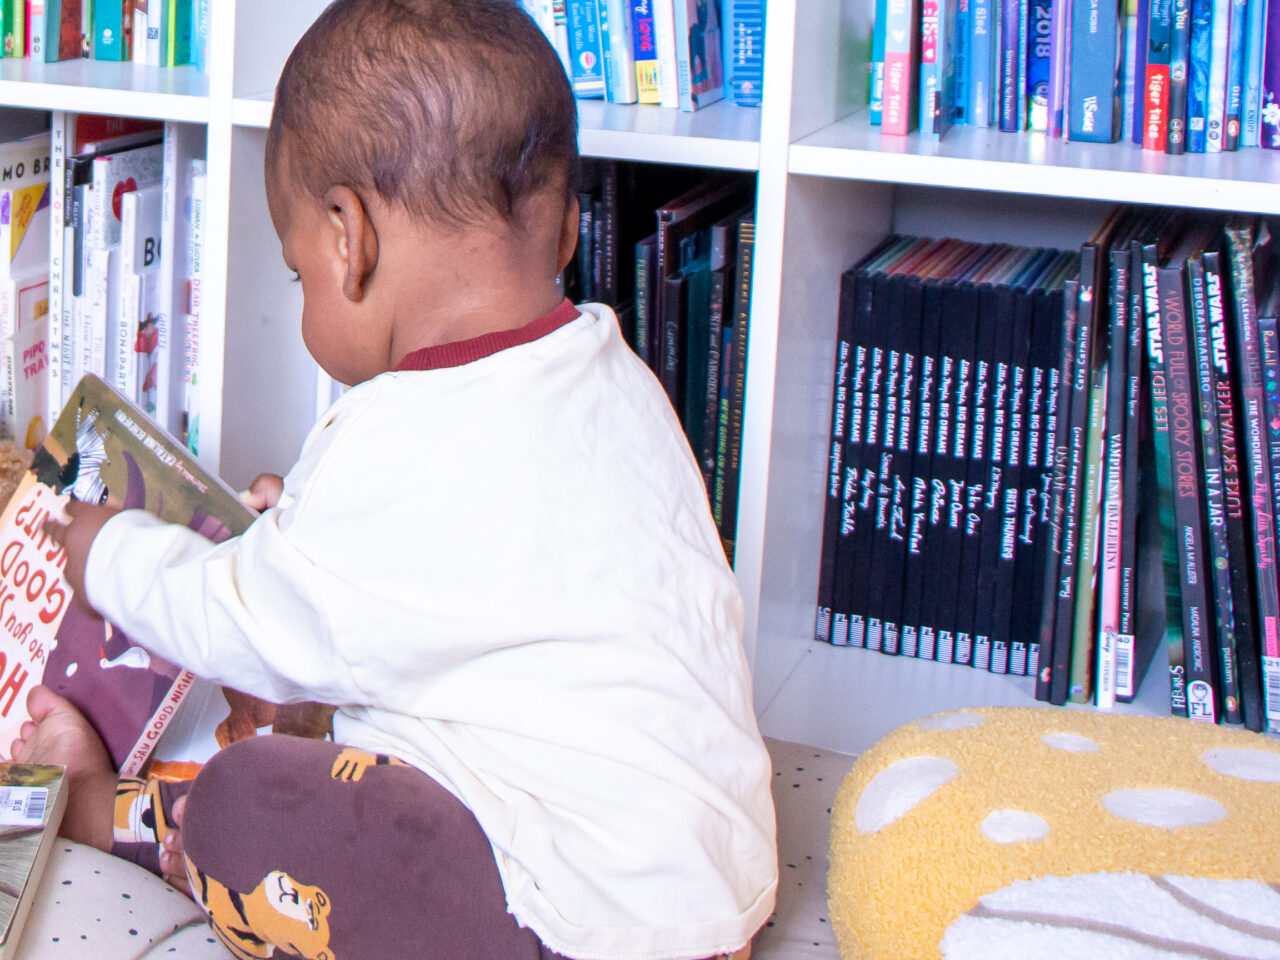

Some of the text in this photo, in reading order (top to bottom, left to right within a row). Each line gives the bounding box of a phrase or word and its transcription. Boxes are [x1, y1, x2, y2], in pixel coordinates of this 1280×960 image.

[638, 17, 653, 52] love
[974, 6, 989, 35] Sled
[1034, 5, 1053, 58] 2018
[1175, 10, 1188, 31] You
[888, 61, 903, 124] tiger tales
[1148, 73, 1163, 138] tiger tales
[190, 278, 201, 367] DEAR TREEFROG
[1142, 262, 1164, 364] STAR WARS
[1206, 271, 1229, 374] STAR WARS
[22, 339, 46, 364] PIPO
[1192, 277, 1210, 392] DEBORAH MARCERO
[707, 350, 719, 401] CABOODLE
[1165, 296, 1197, 498] WORLD FULL SPOOKY STORIES
[718, 397, 729, 453] WE'RE GOING
[836, 403, 846, 437] DREAMS
[852, 408, 863, 442] DREAMS
[869, 410, 879, 444] DREAMS
[885, 413, 895, 447] DREAMS
[900, 416, 910, 450] DREAMS
[920, 419, 930, 453] DREAMS
[940, 419, 950, 454] DREAMS
[957, 423, 967, 457] DREAMS
[974, 424, 984, 459] DREAMS
[994, 426, 1004, 461] DREAMS
[1010, 430, 1020, 465] DREAMS
[1029, 431, 1039, 466] DREAMS
[1217, 380, 1242, 519] LUKE SKYWALKER
[1249, 417, 1263, 477] WONDERFUL
[929, 478, 946, 526] Prince
[1106, 433, 1122, 571] VAMPIRINA BALLERINA
[1209, 499, 1223, 527] JAR
[1000, 516, 1017, 561] THUNBERG
[0, 539, 67, 625] GOOD
[4, 611, 34, 646] you
[28, 638, 45, 663] do
[1222, 646, 1235, 683] putnam
[133, 742, 150, 761] SAY
[145, 704, 175, 741] GOOD
